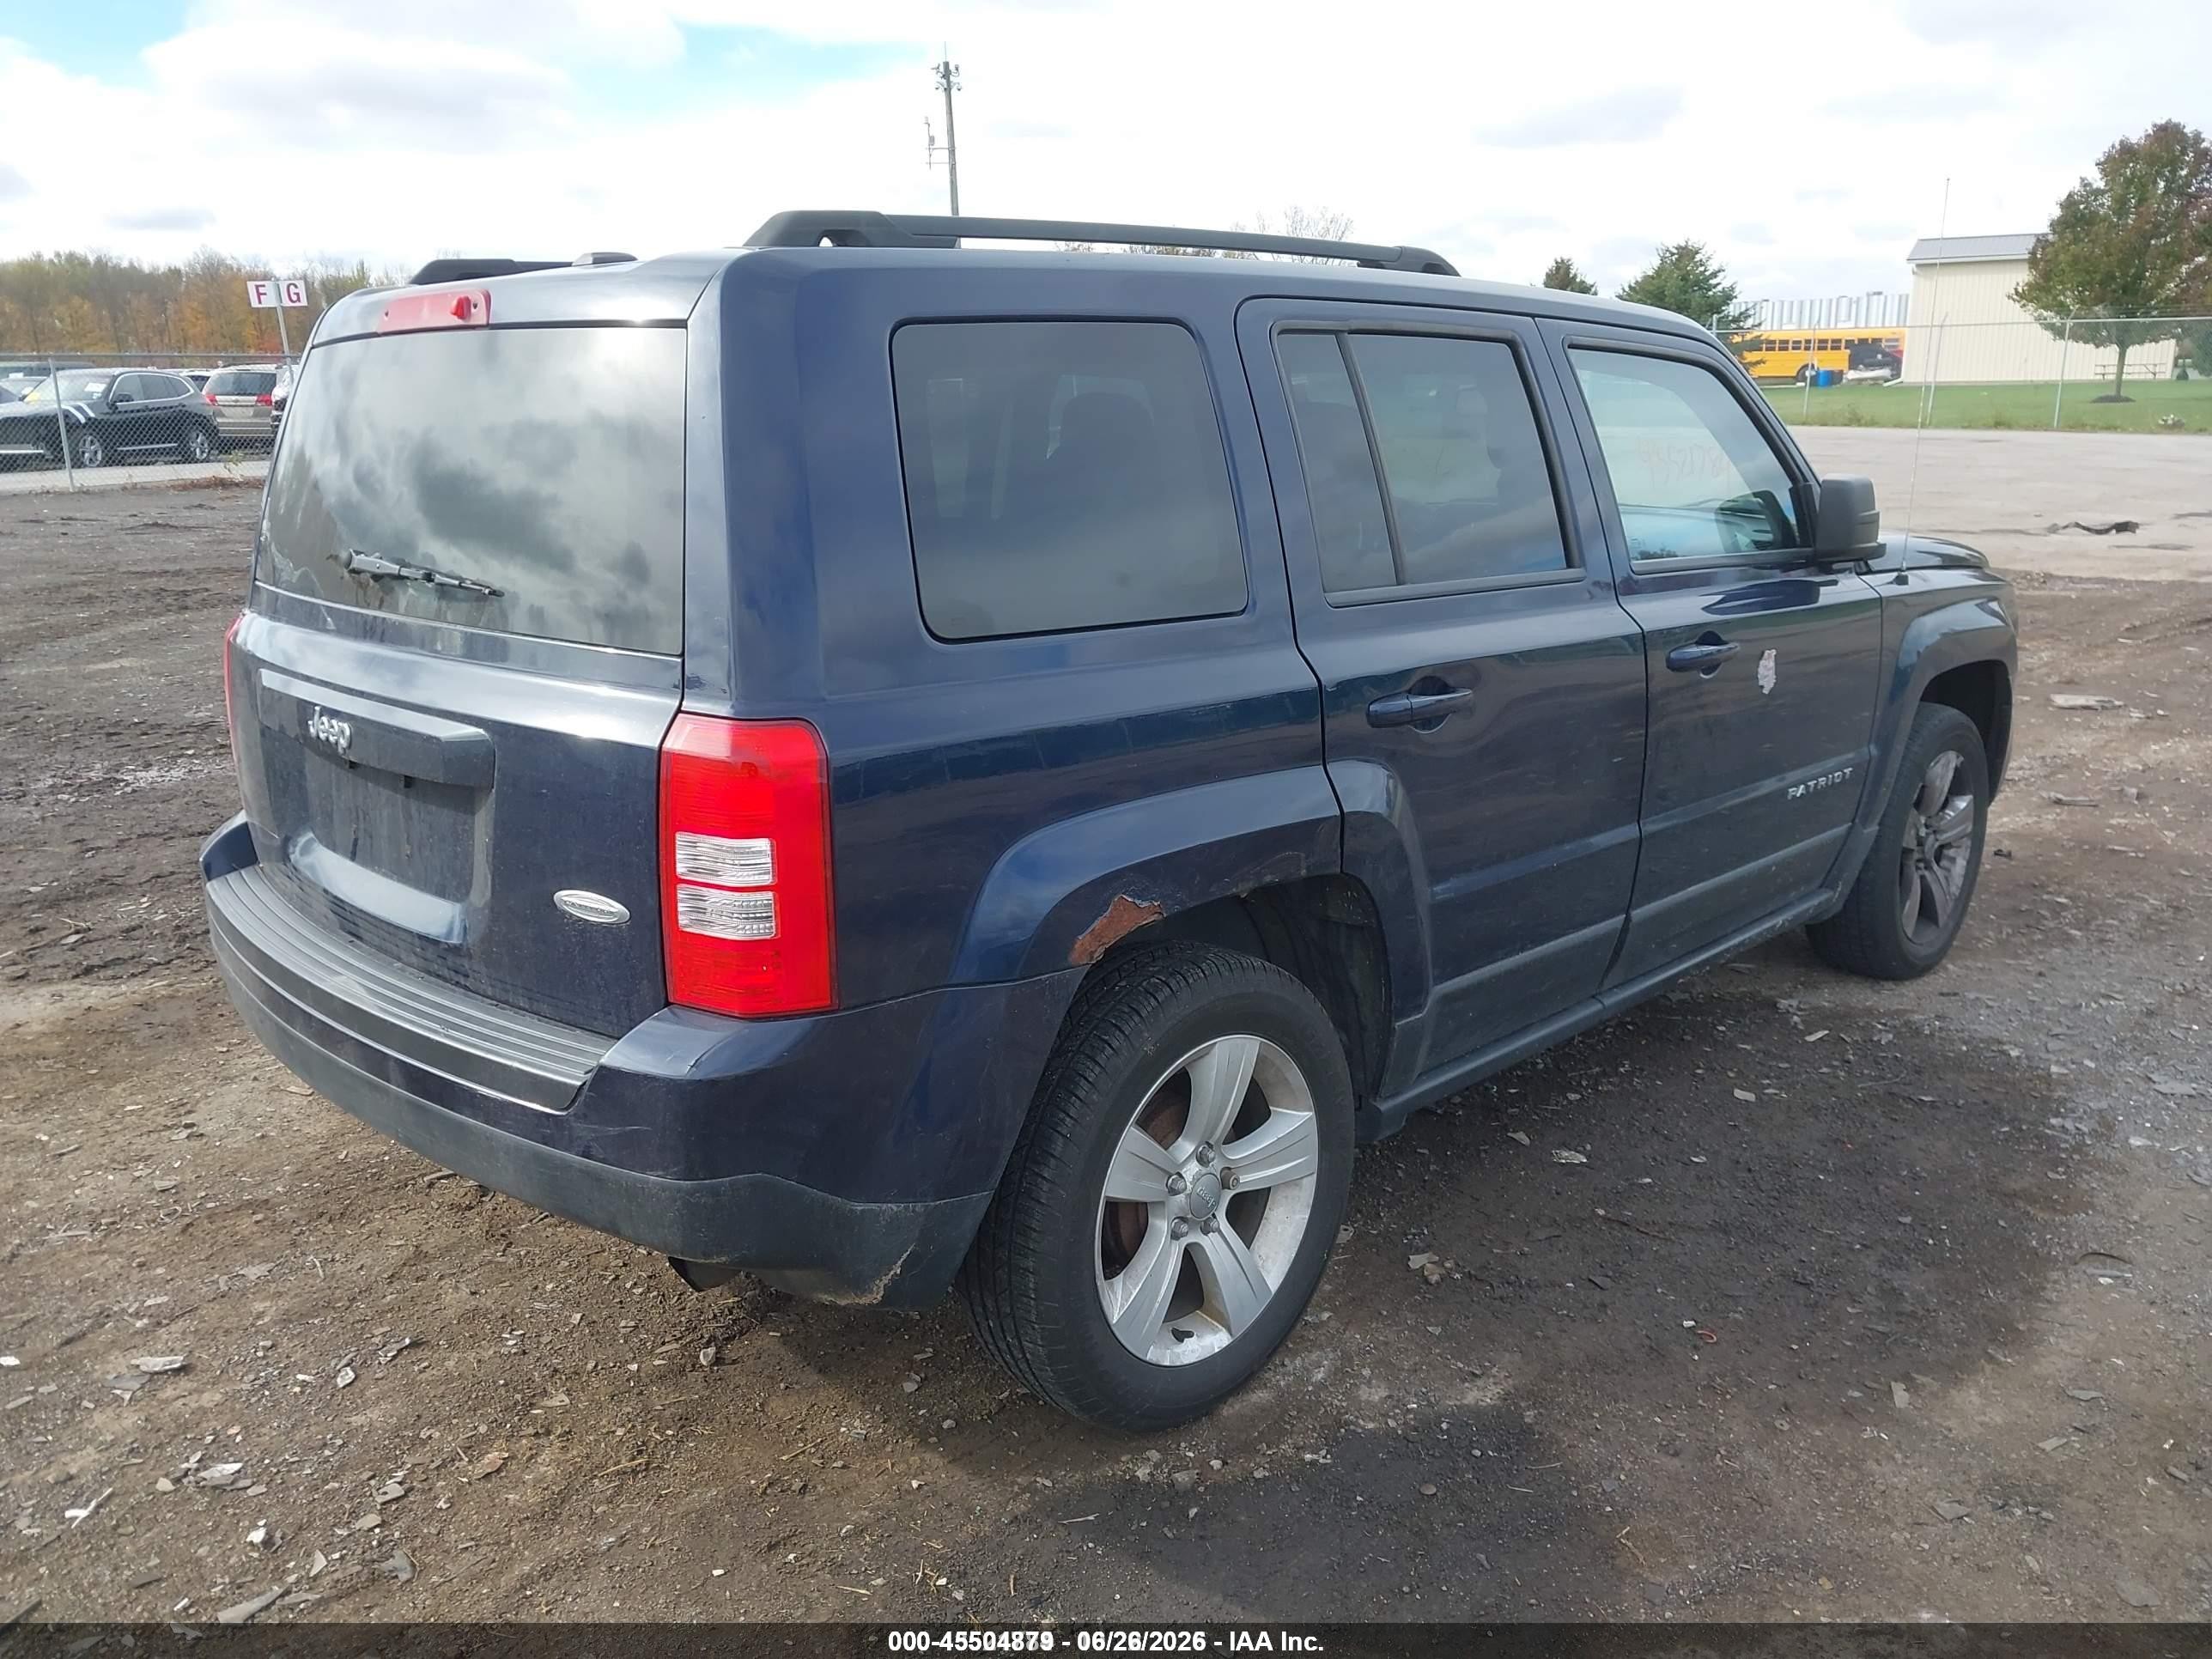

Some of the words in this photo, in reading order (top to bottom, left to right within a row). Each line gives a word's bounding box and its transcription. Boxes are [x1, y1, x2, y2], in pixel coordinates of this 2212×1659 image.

[254, 284, 267, 305] F
[286, 283, 301, 303] G
[307, 706, 351, 755] Jeep
[1787, 767, 1853, 800] PATRIOT
